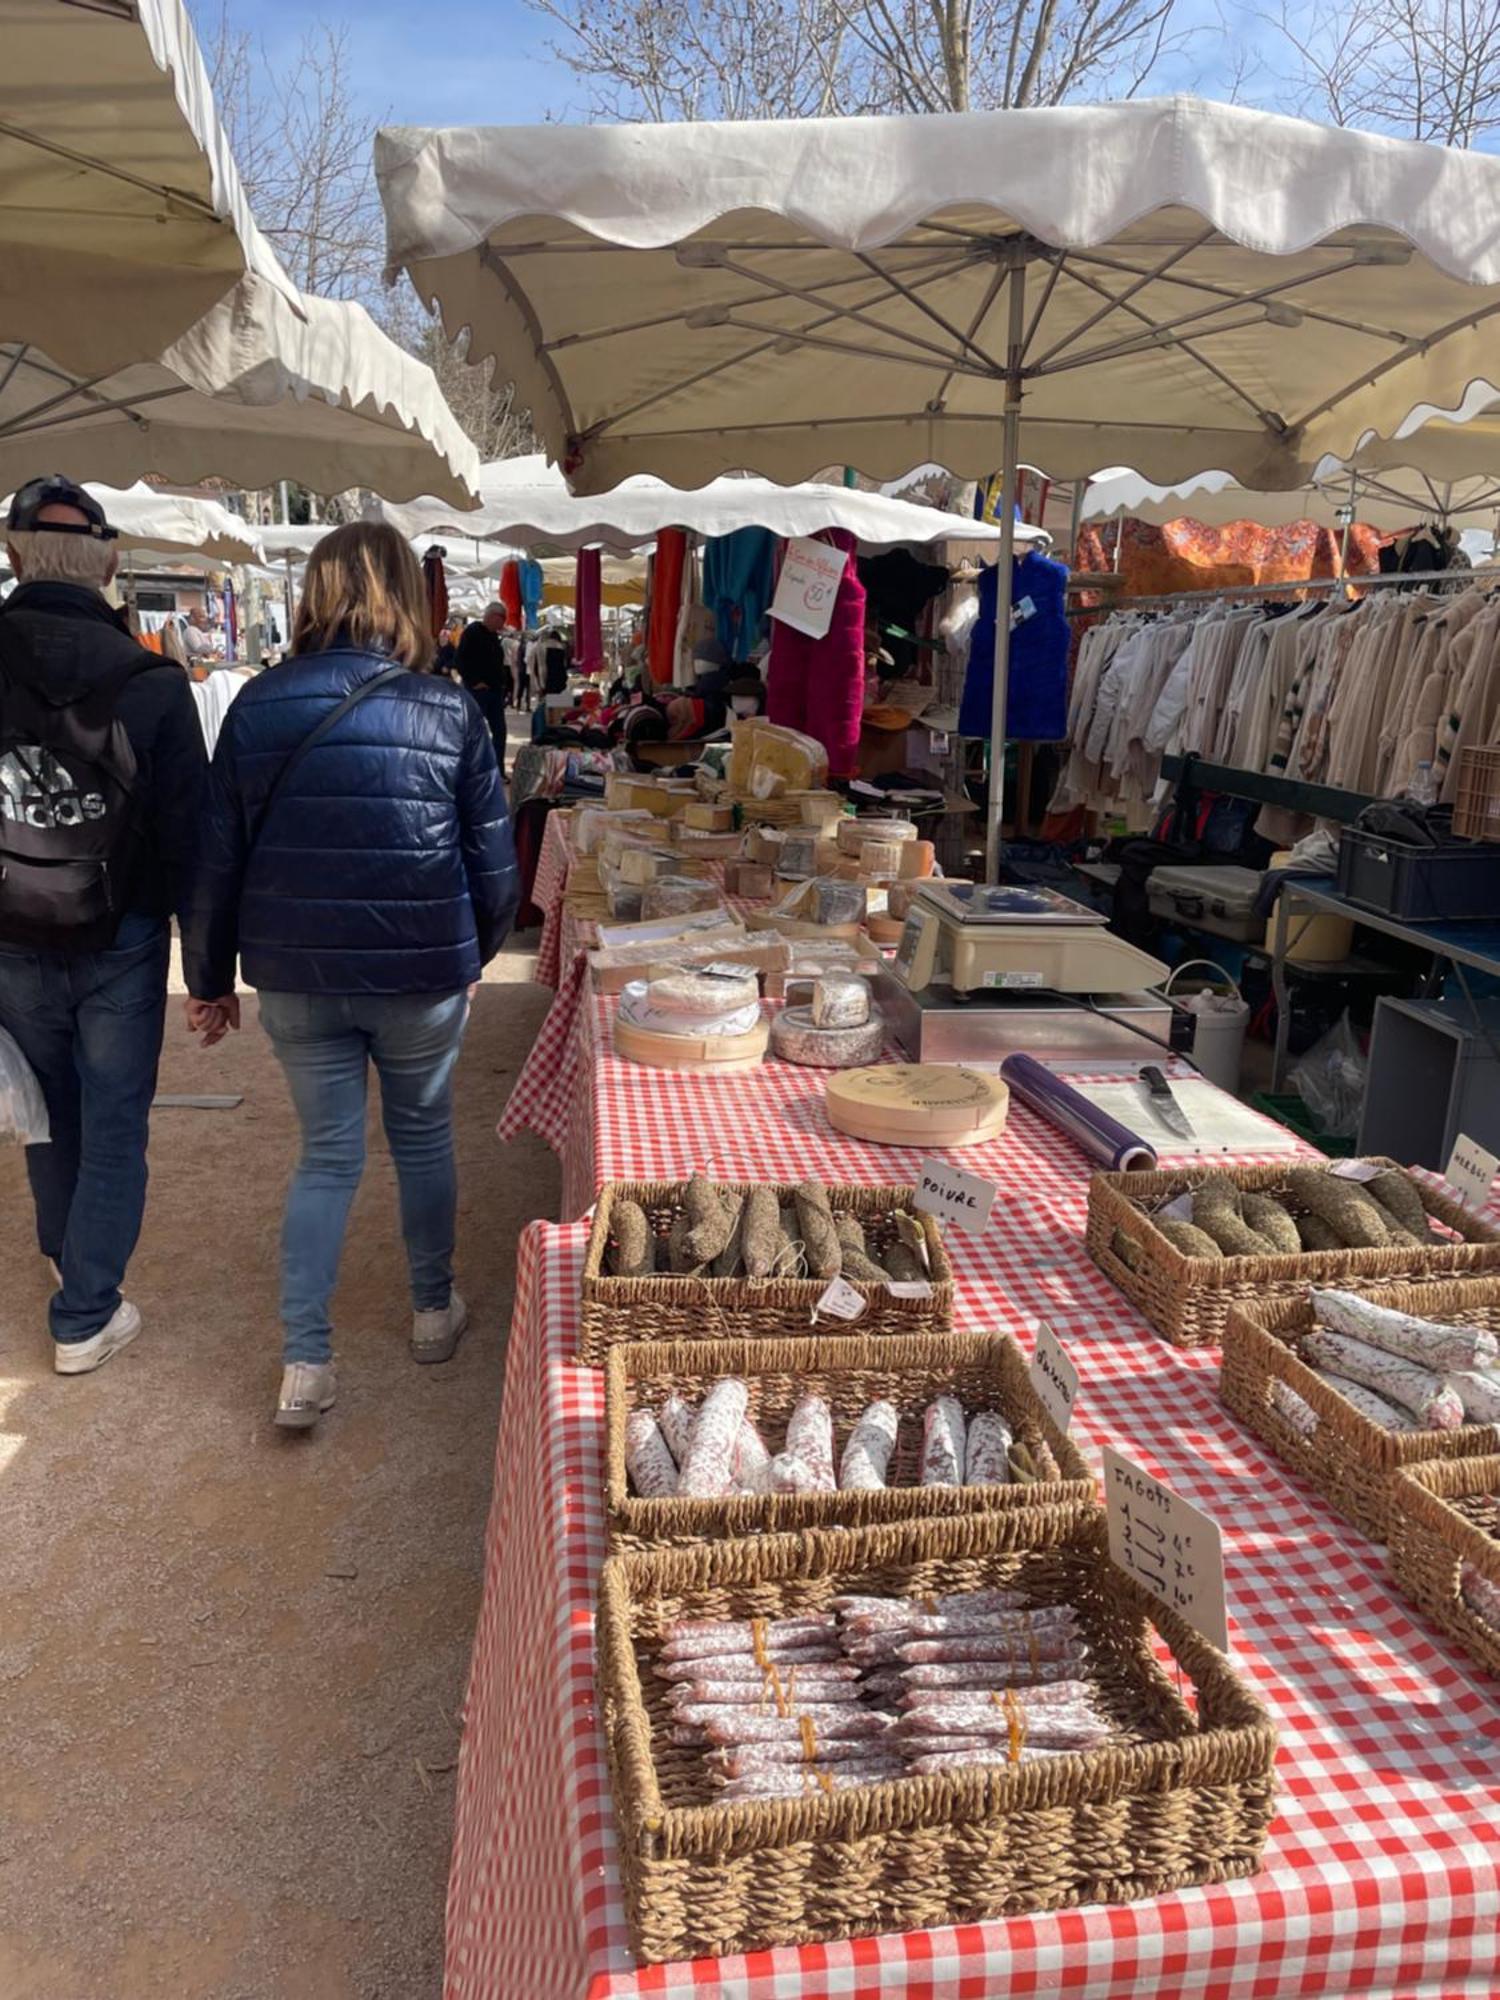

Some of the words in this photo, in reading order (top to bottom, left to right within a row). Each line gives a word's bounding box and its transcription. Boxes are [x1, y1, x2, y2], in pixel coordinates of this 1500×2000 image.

[1113, 1467, 1171, 1514] FAGOTS
[1122, 1525, 1133, 1543] 2
[1124, 1547, 1135, 1568] 3
